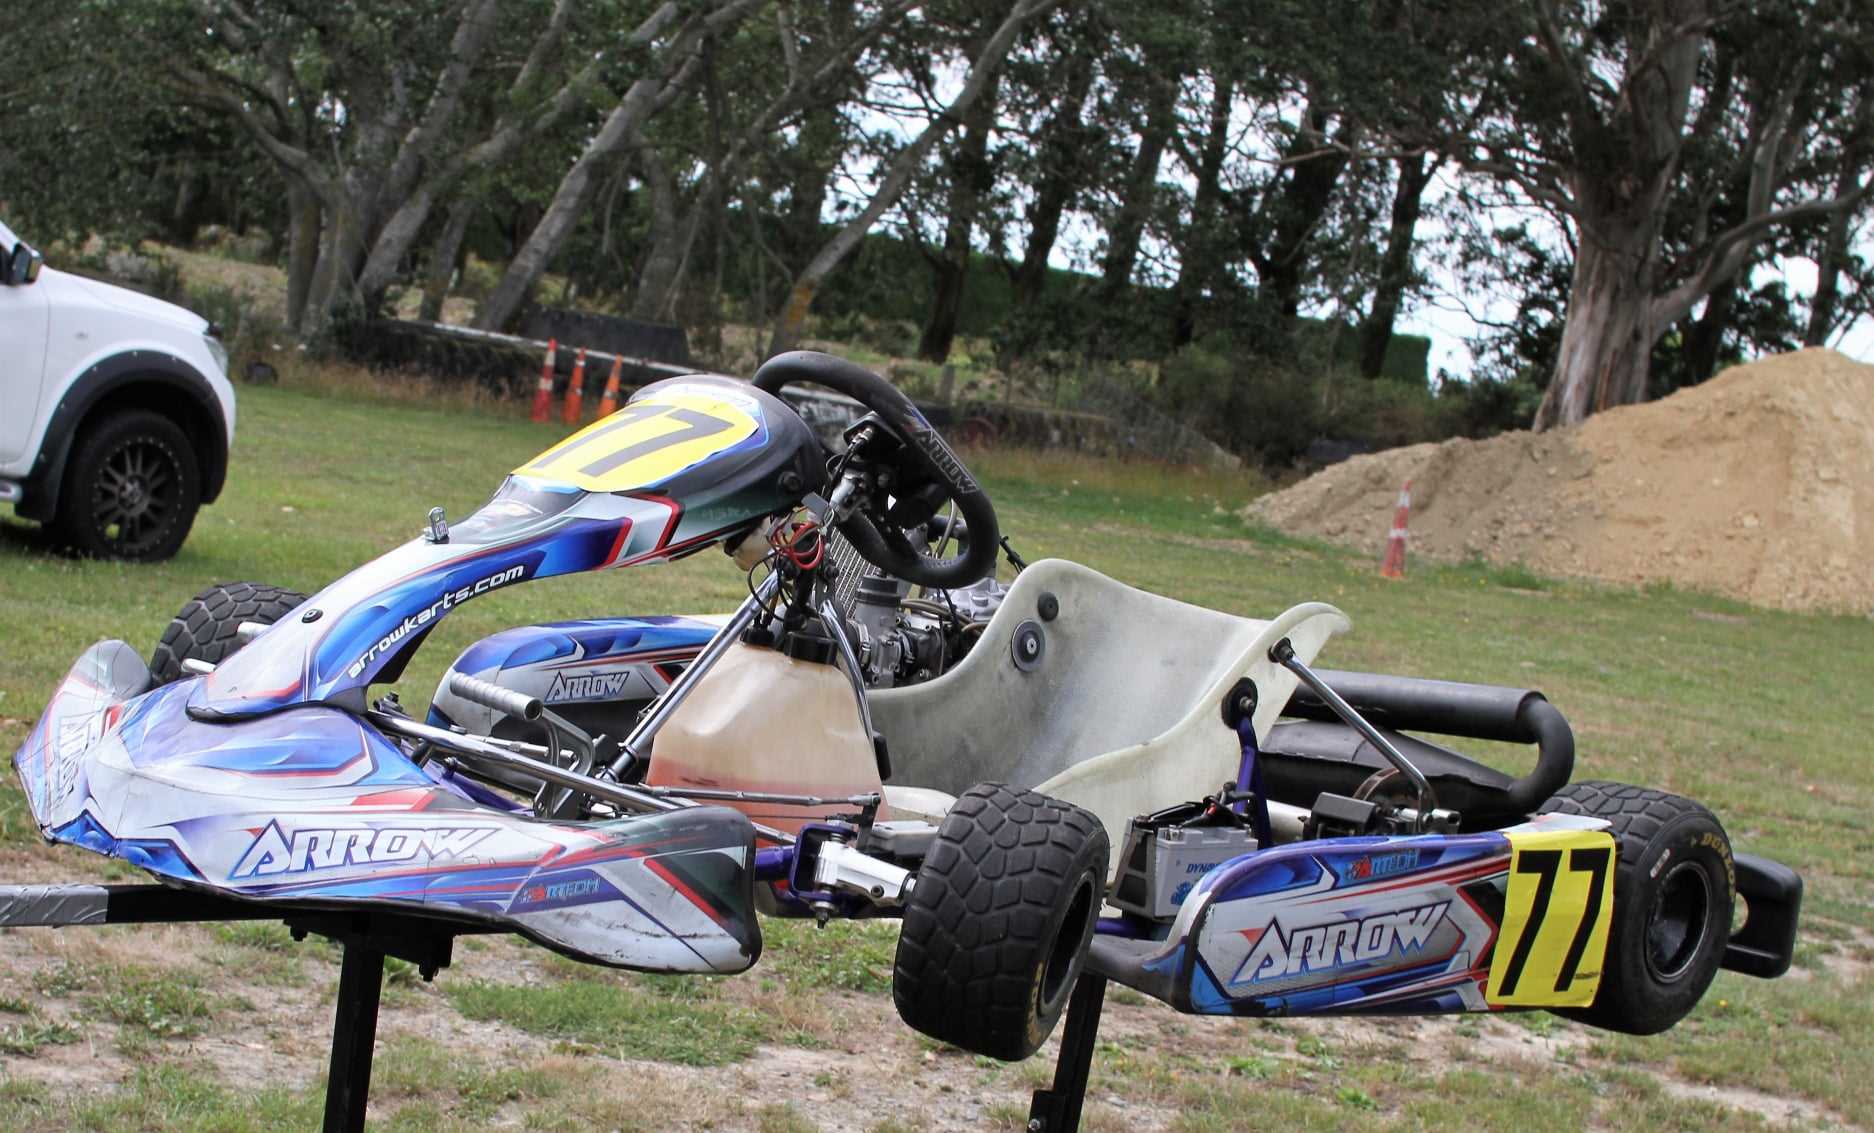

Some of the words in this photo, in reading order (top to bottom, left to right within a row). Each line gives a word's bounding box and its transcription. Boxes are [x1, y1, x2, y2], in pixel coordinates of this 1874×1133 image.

[529, 405, 735, 477] 77
[348, 565, 525, 679] arrowkarts.com
[543, 670, 631, 704] ARROW
[226, 818, 501, 880] ARROW
[1228, 899, 1451, 986] ARROW
[1497, 848, 1611, 996] 77
